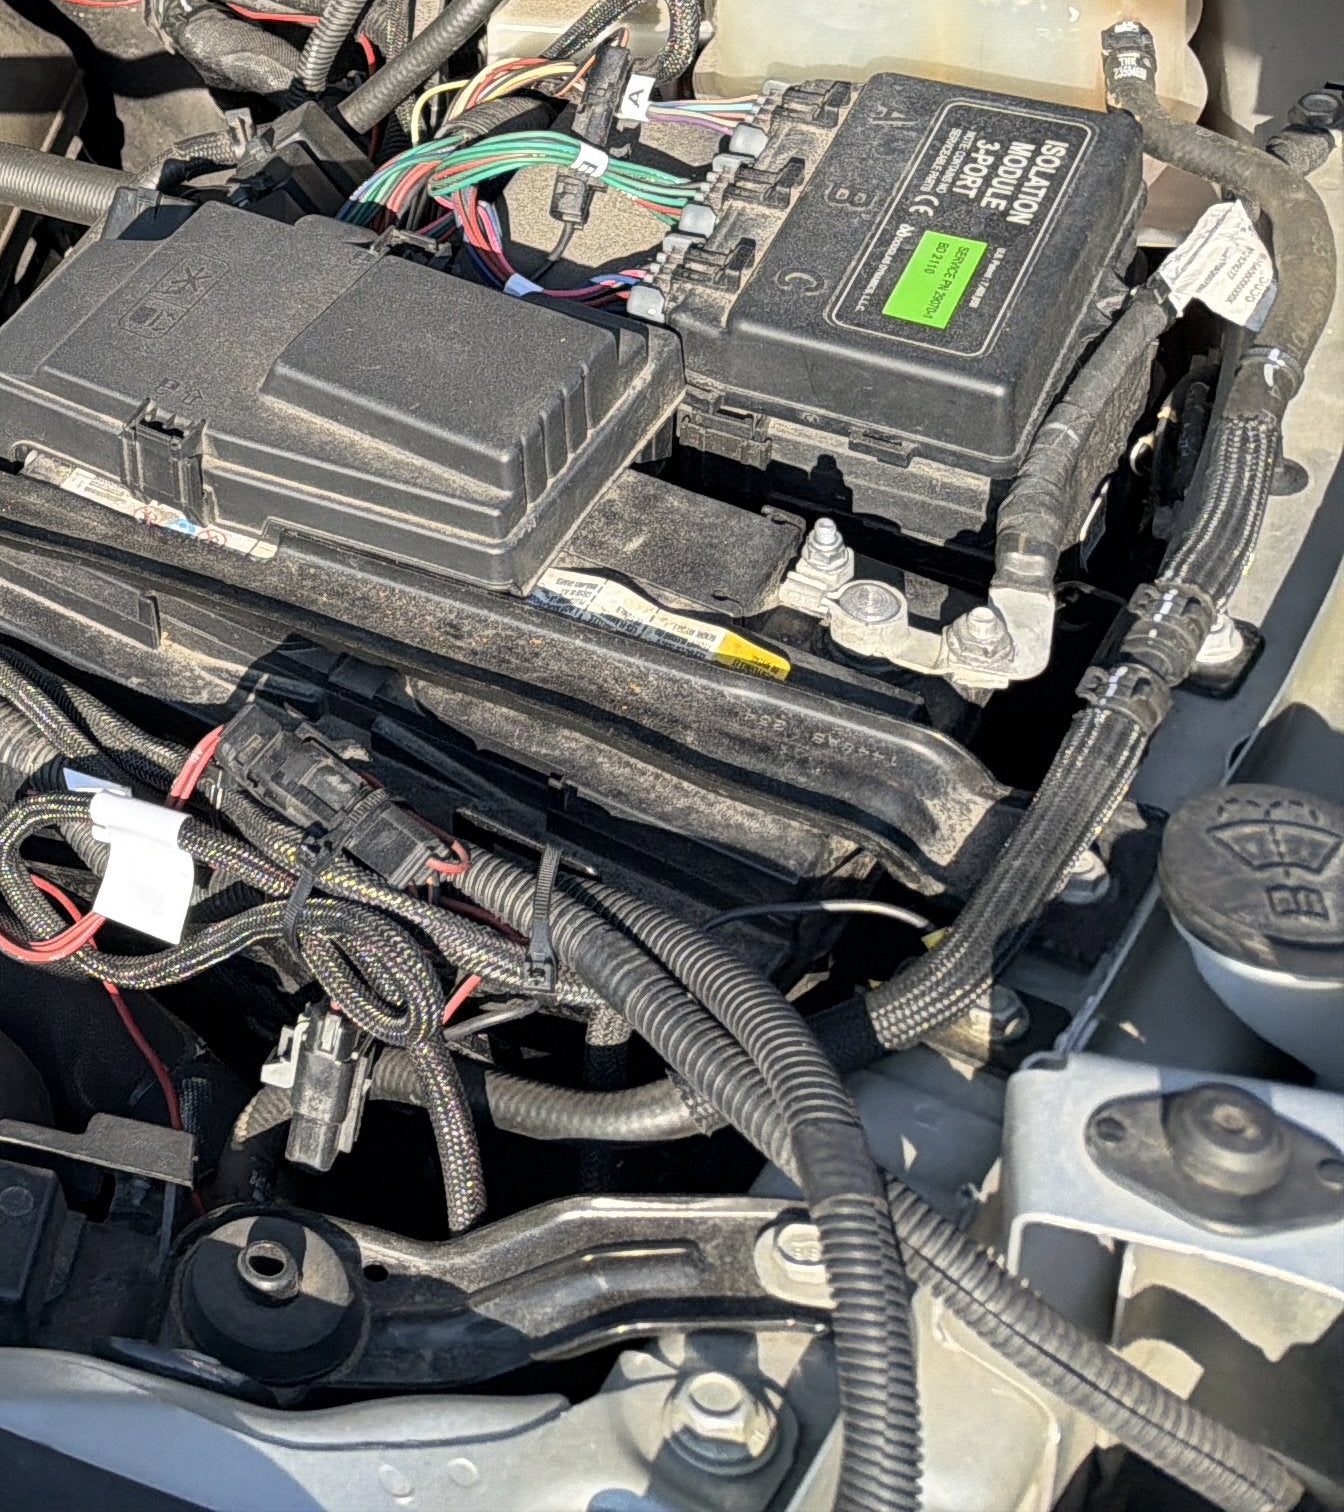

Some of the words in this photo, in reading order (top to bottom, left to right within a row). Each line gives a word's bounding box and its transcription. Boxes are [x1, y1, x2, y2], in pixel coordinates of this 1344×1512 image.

[628, 89, 645, 109] A
[952, 139, 1001, 199] 3-PORT
[980, 141, 1036, 210] MODULE
[1005, 139, 1069, 225] ISOLATION
[923, 253, 943, 275] 2110
[943, 246, 969, 278] SERVICE
